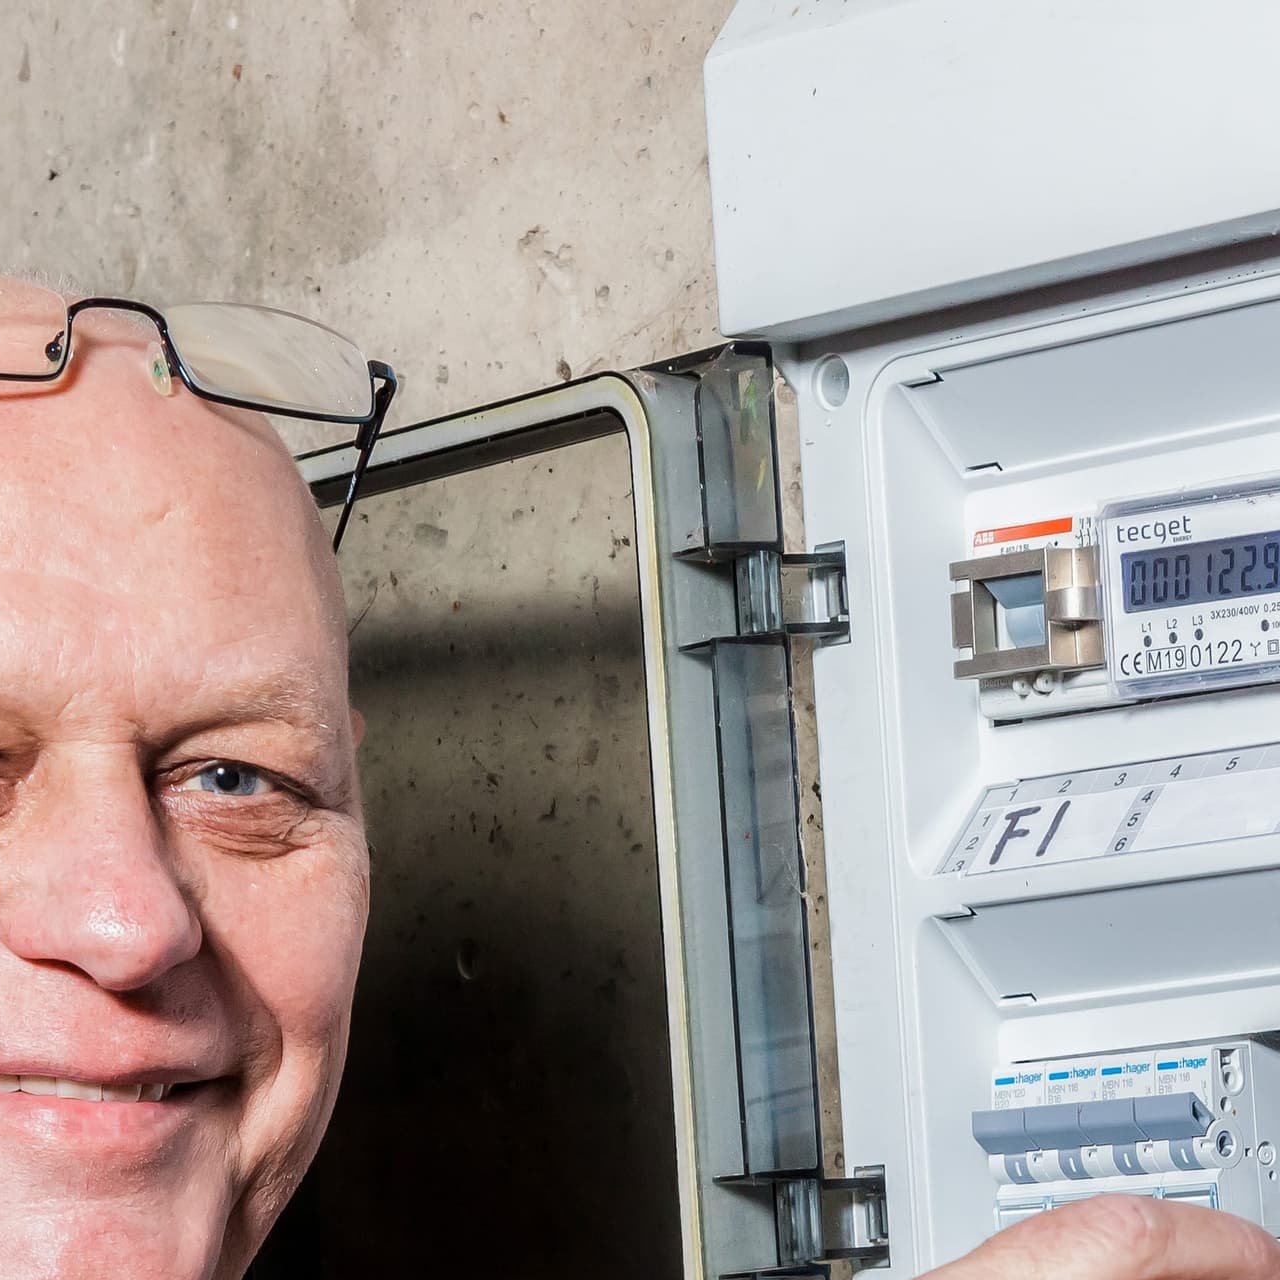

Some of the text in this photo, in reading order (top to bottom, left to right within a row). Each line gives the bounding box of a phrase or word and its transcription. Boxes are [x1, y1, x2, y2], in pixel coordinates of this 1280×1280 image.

[1117, 515, 1192, 544] tecget
[1173, 535, 1192, 543] ENERGY
[1210, 604, 1259, 620] 3X230/400V
[1142, 622, 1152, 633] L1
[1166, 618, 1178, 630] L2
[1192, 615, 1204, 626] L3
[1148, 648, 1185, 671] M19
[1190, 639, 1243, 667] 0122
[1009, 788, 1019, 802] 1
[1057, 779, 1072, 793] 2
[1113, 772, 1128, 787] 3
[1169, 764, 1183, 779] 4
[1225, 757, 1240, 771] 5
[1140, 789, 1155, 803] 4
[982, 814, 992, 827] 1
[1126, 812, 1141, 827] 5
[965, 836, 980, 850] 2
[1114, 837, 1128, 851] 6
